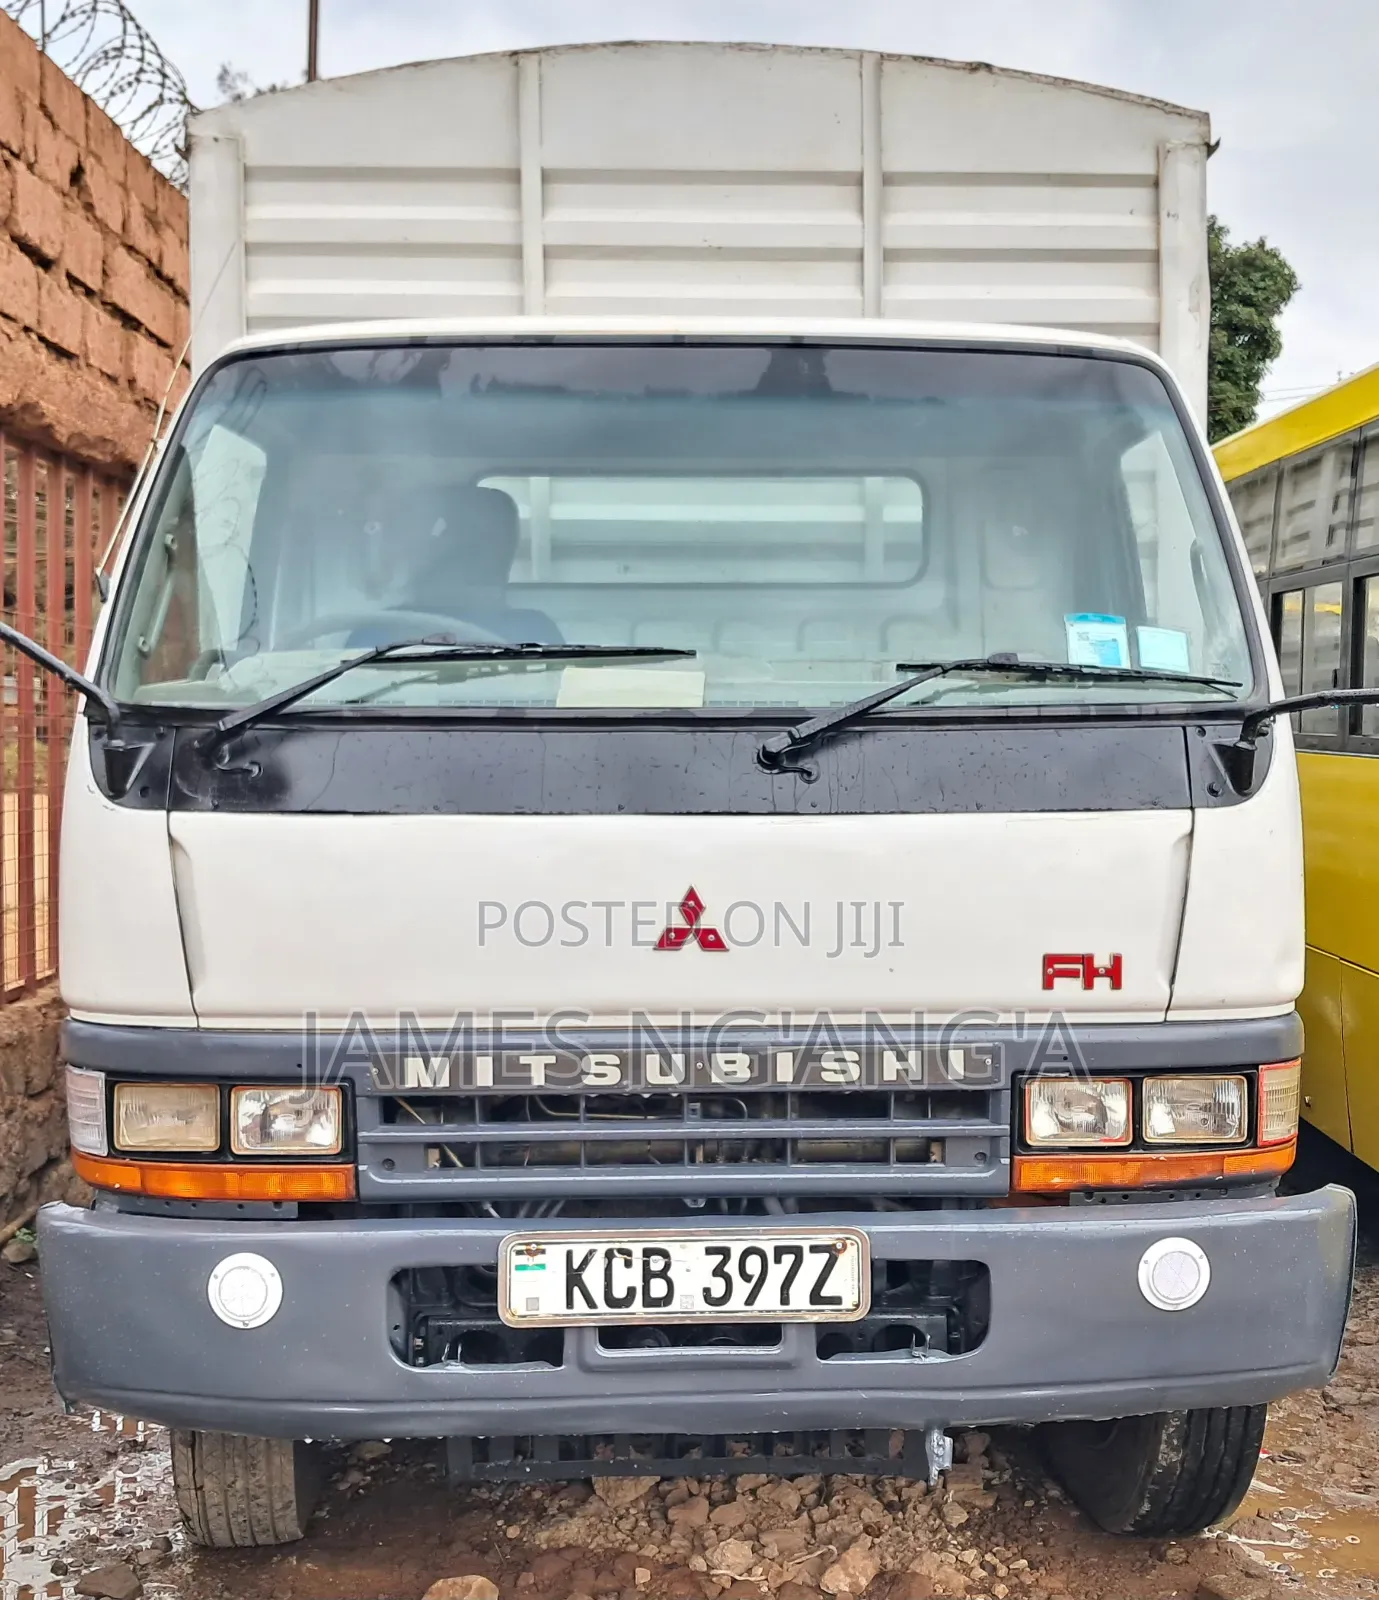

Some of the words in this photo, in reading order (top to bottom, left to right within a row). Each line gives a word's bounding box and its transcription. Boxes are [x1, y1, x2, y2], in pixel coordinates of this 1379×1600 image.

[1042, 953, 1122, 990] FH
[404, 1048, 965, 1089] MITSUBISHI
[566, 1247, 675, 1310] KCB
[702, 1244, 843, 1307] 397Z
